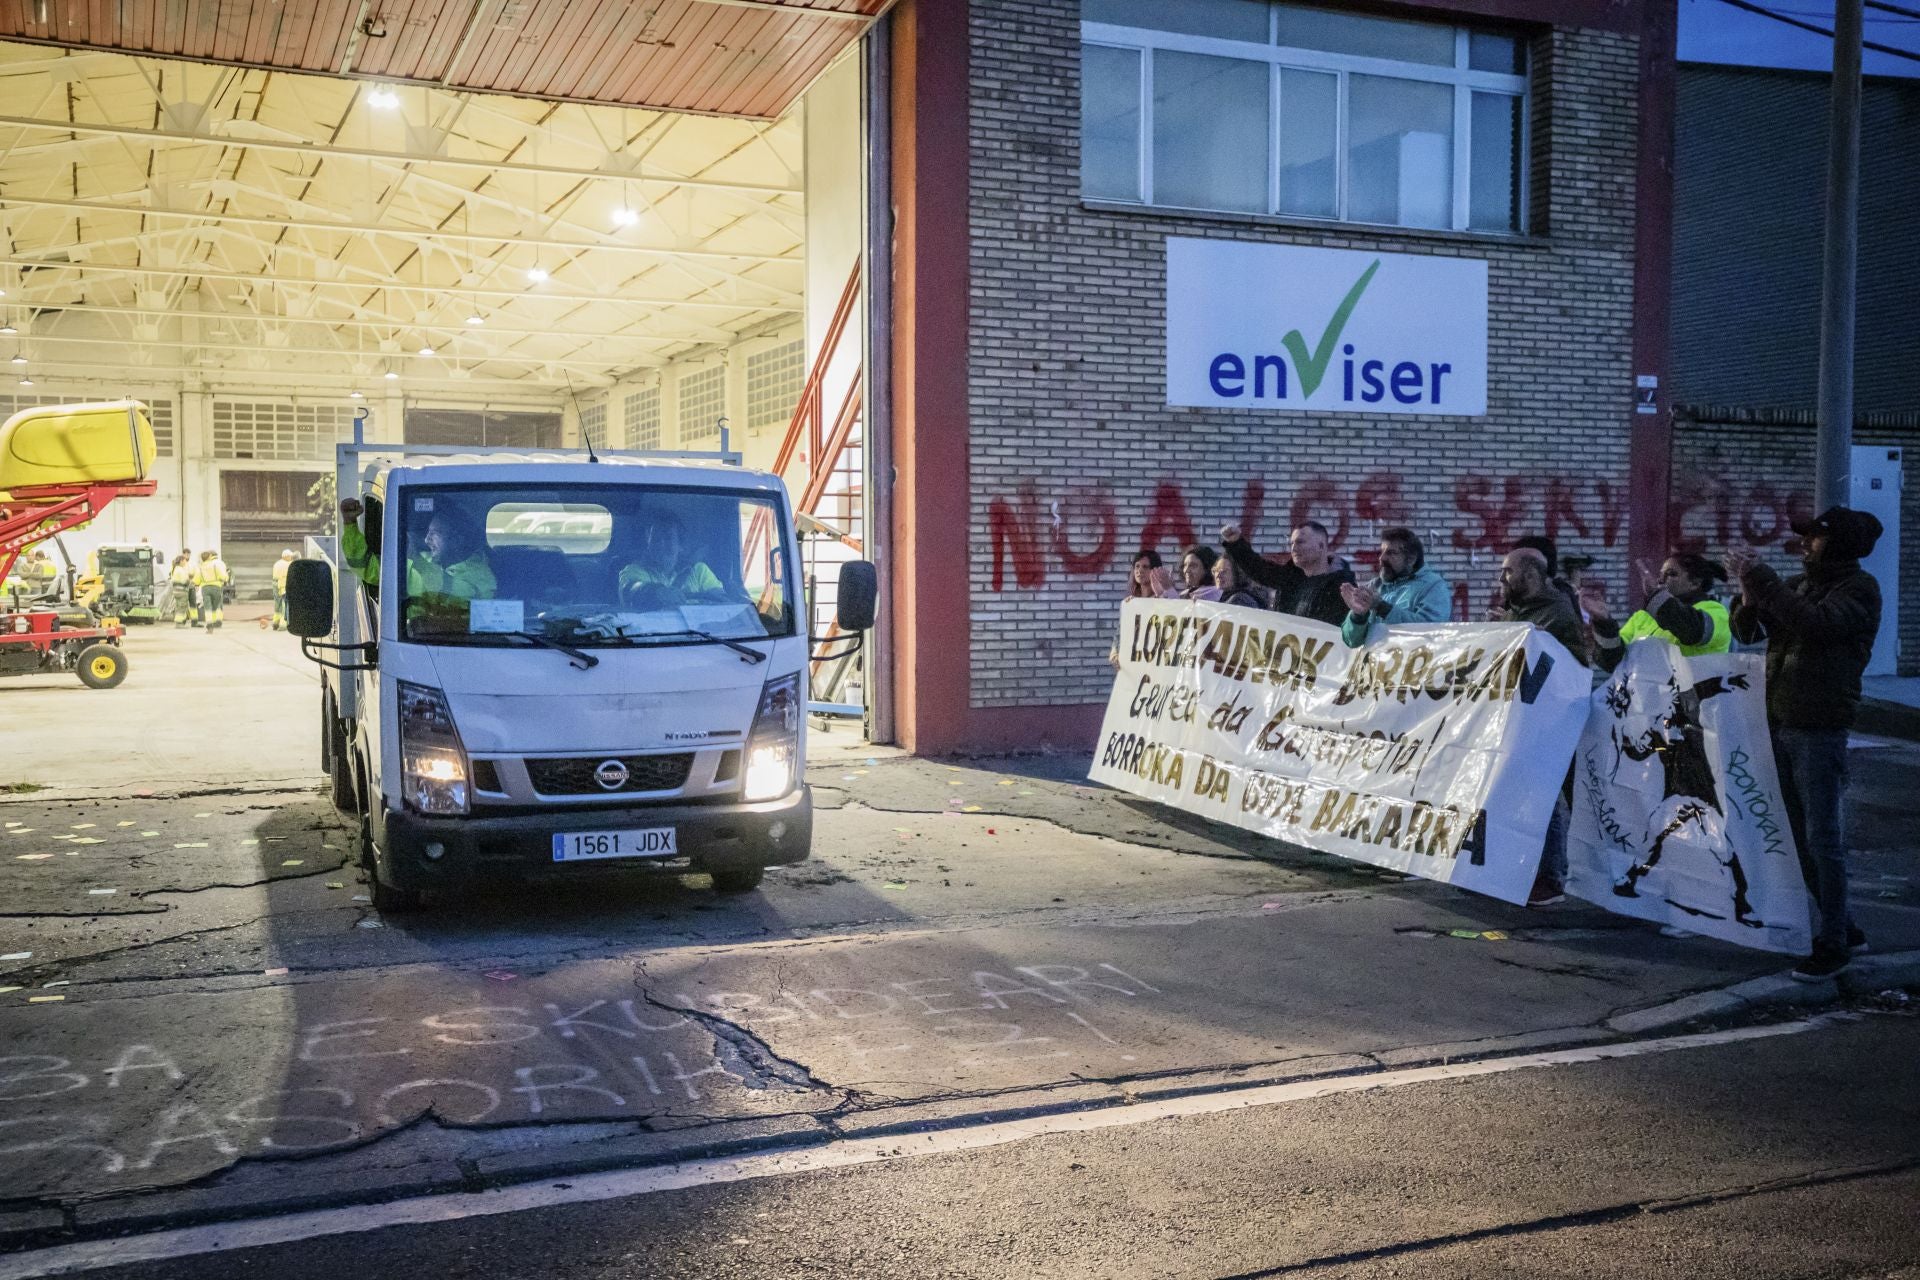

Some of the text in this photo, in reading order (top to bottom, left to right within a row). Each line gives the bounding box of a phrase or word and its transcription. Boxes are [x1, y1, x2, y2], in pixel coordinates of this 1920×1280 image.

[988, 479, 1118, 593] NO
[1140, 481, 1200, 554] A
[1131, 613, 1335, 692] LOREZAINOK
[1207, 689, 1254, 735] da
[1101, 731, 1185, 790] BORROKA
[1194, 753, 1231, 803] DA
[1309, 789, 1487, 866] BAKARRA
[574, 831, 672, 856] 1561 JDX
